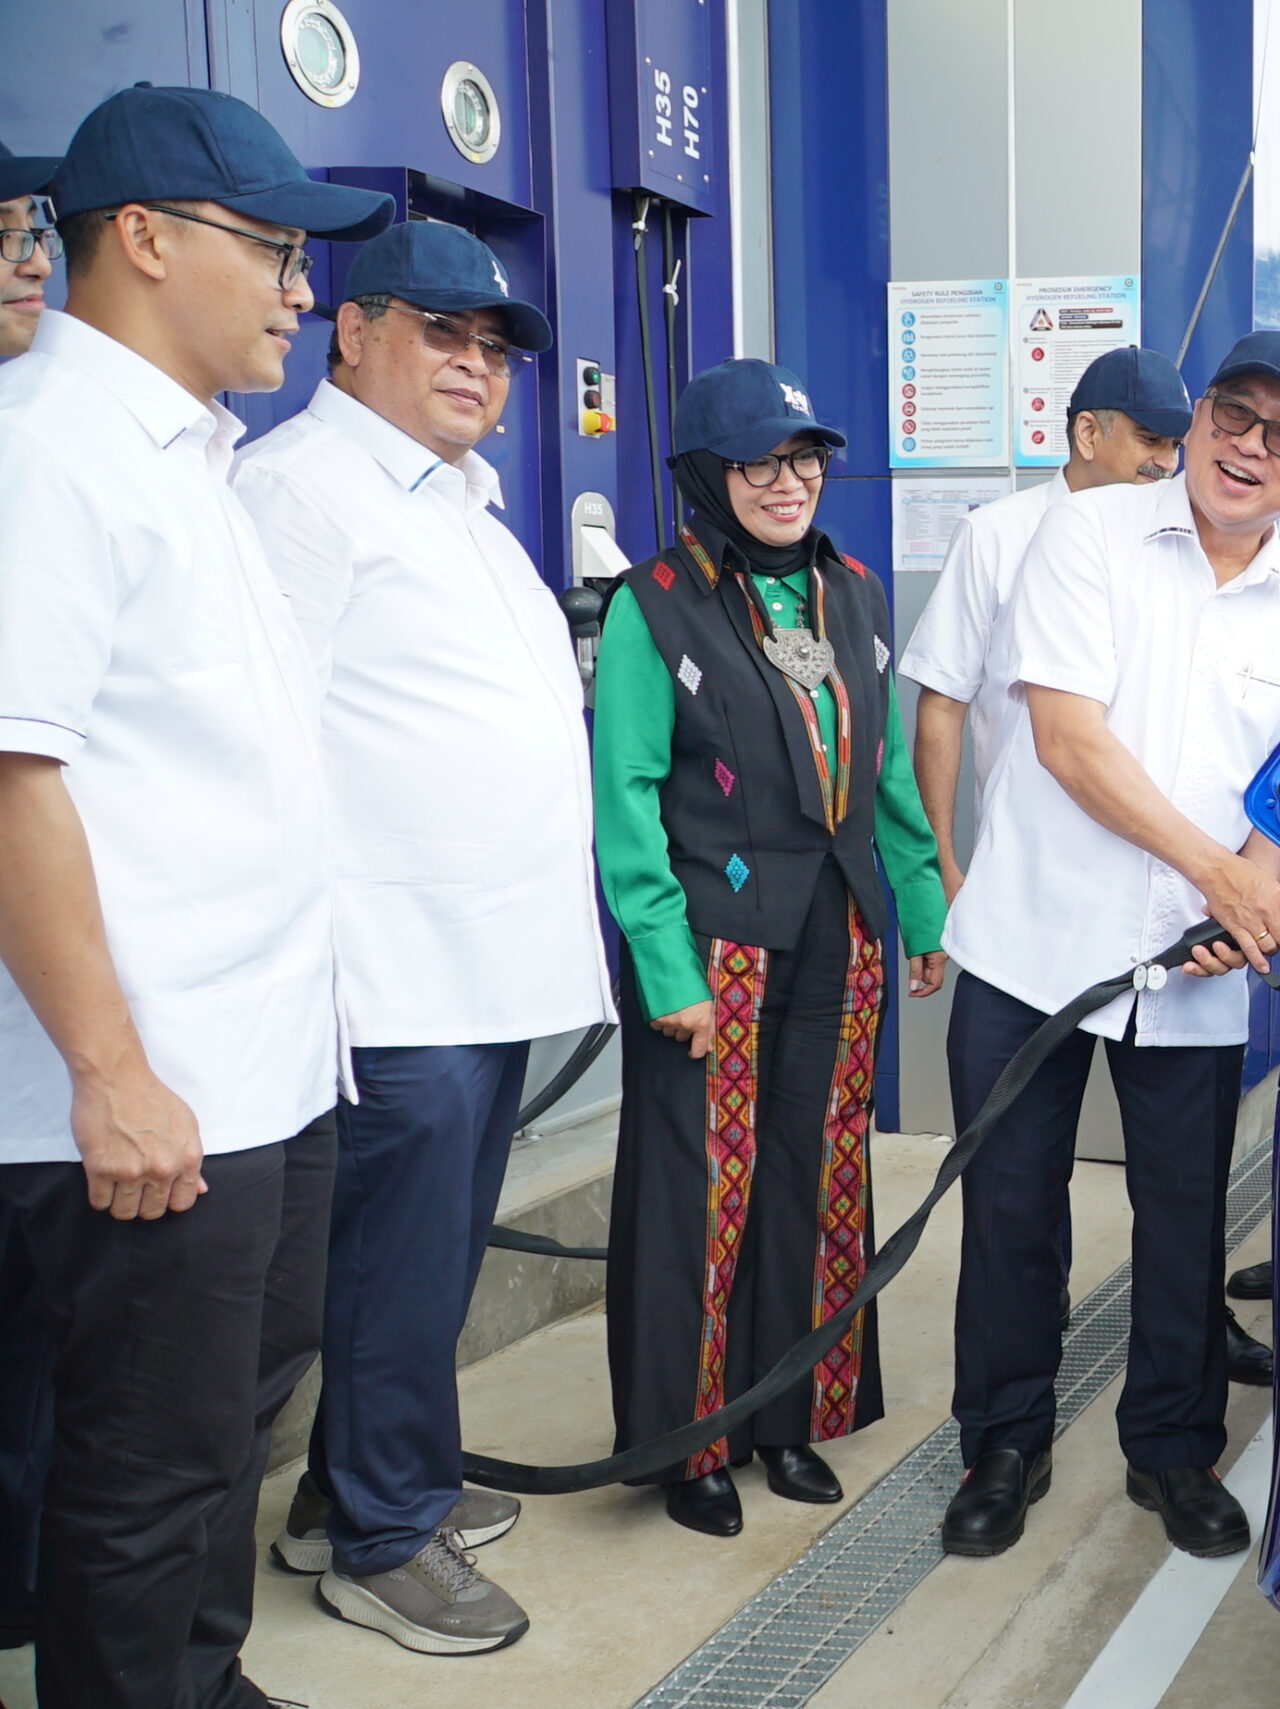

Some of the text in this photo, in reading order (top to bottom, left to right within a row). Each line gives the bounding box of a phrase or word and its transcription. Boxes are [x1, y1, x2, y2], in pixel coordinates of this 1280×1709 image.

[654, 68, 672, 147] H35
[682, 85, 700, 160] H70
[584, 502, 604, 516] H35
